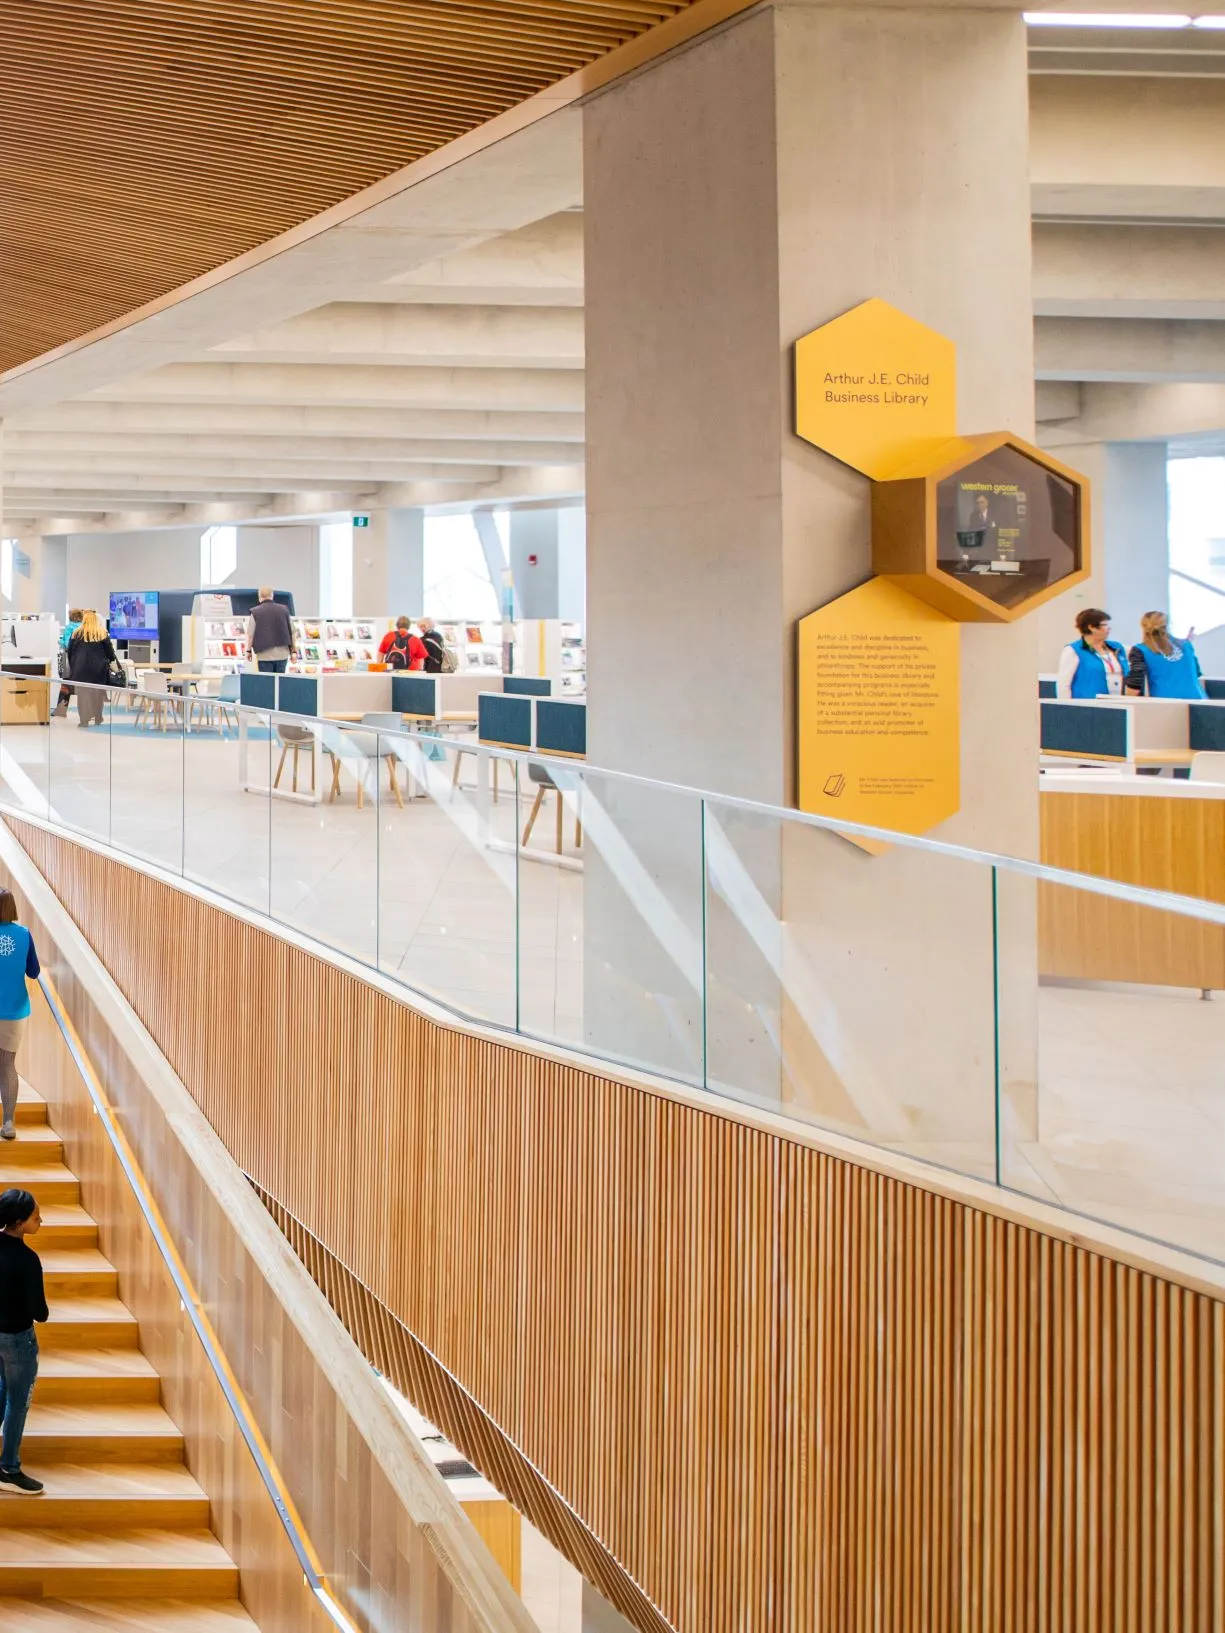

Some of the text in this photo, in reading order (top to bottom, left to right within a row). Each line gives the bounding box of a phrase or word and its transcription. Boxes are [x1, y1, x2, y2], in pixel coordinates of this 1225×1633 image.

[824, 372, 929, 386] Arthur J.E. Child
[824, 390, 928, 406] Business Library
[880, 654, 911, 662] generosity
[871, 663, 895, 671] support
[902, 673, 922, 681] library
[865, 710, 891, 718] personal
[892, 710, 912, 718] library
